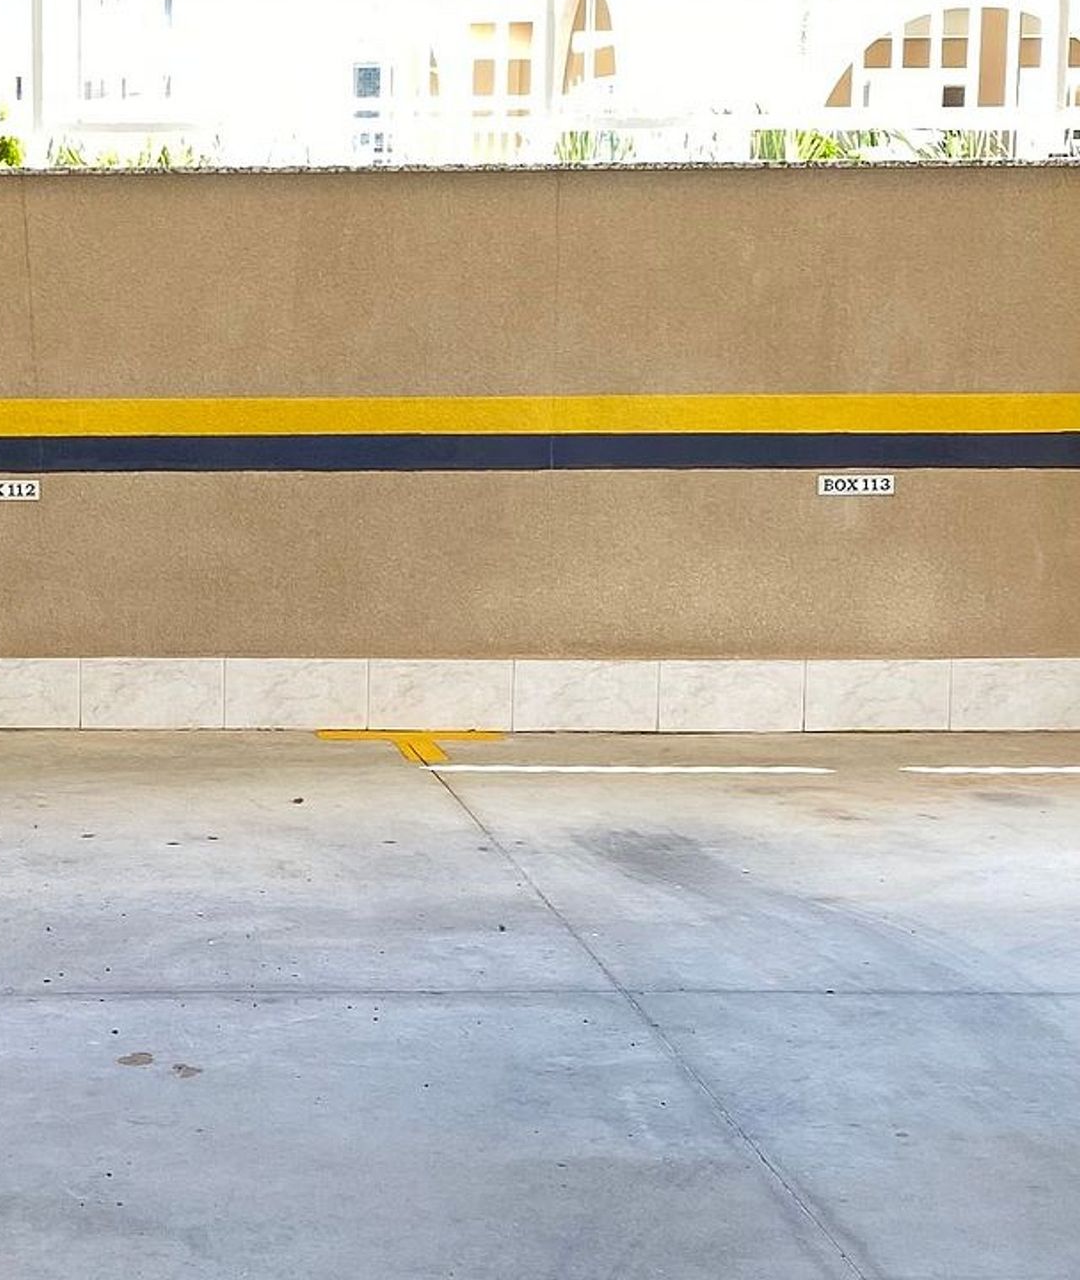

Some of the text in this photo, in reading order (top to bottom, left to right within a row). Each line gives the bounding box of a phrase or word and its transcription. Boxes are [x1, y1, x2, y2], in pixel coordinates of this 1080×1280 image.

[8, 484, 36, 496] 112
[824, 479, 891, 491] BOX 113
